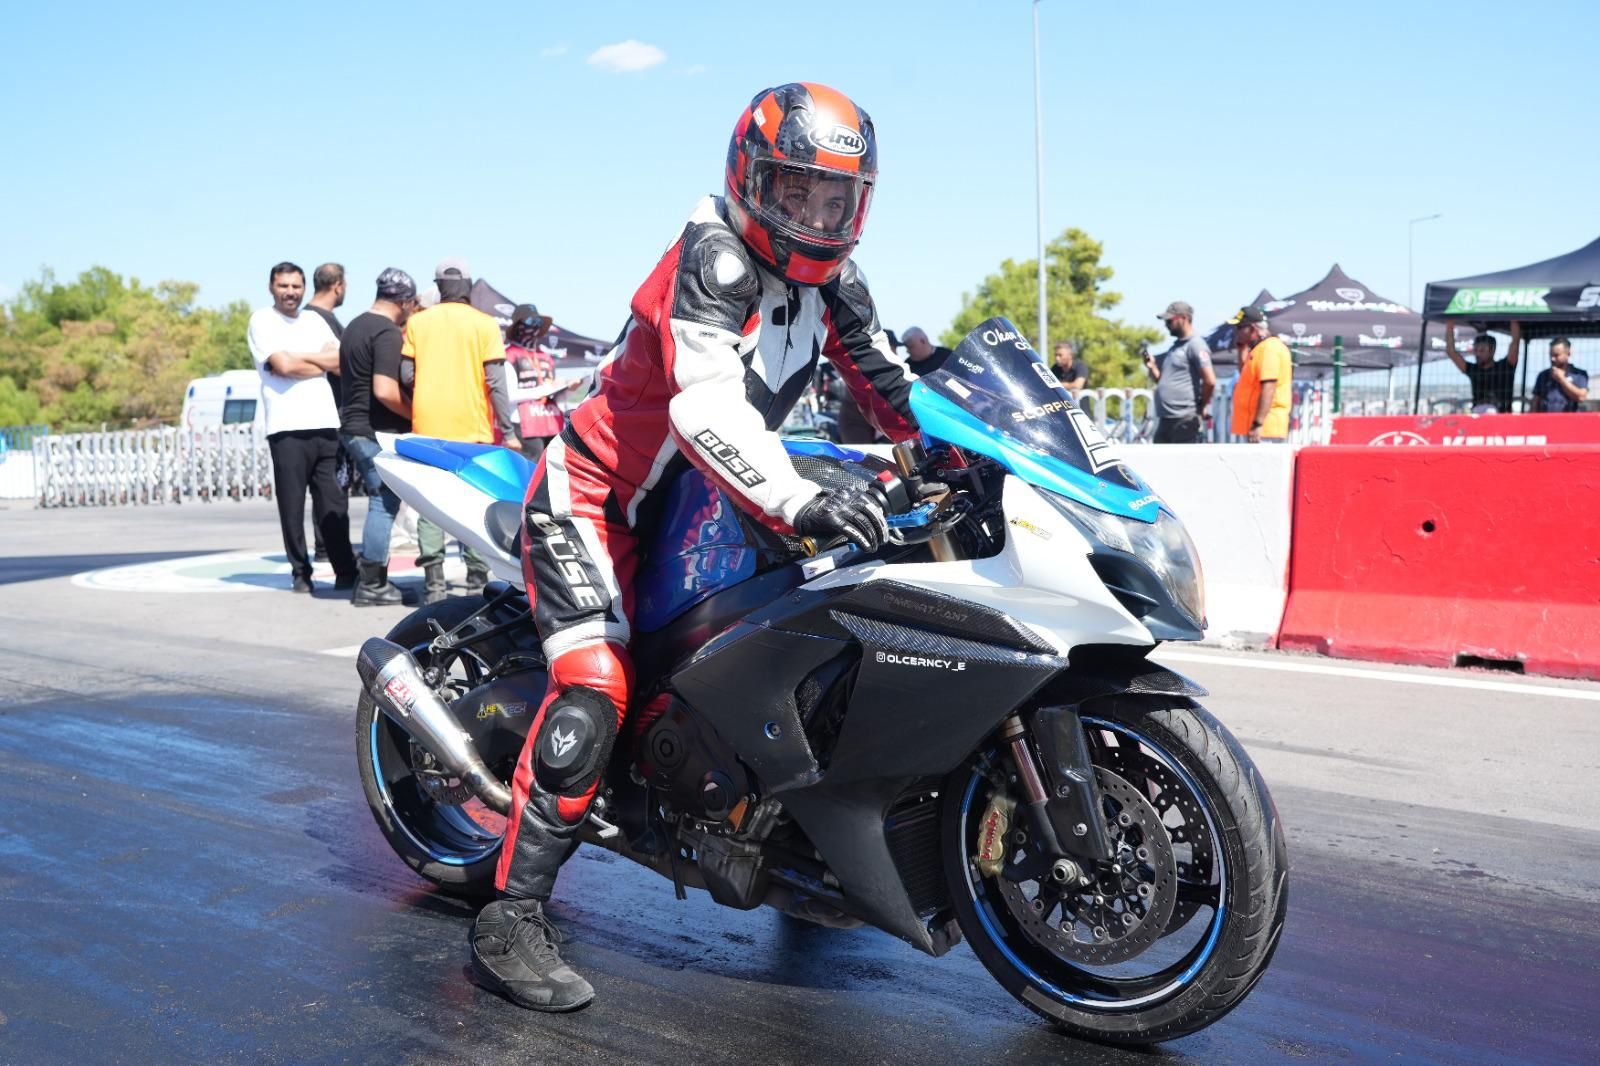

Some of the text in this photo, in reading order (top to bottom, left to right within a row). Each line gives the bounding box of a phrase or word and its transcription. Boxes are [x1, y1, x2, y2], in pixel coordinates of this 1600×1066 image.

[1477, 288, 1550, 308] SMK
[1576, 286, 1600, 309] S
[694, 428, 767, 488] BÜSE
[886, 653, 967, 672] OLCERNCY_E
